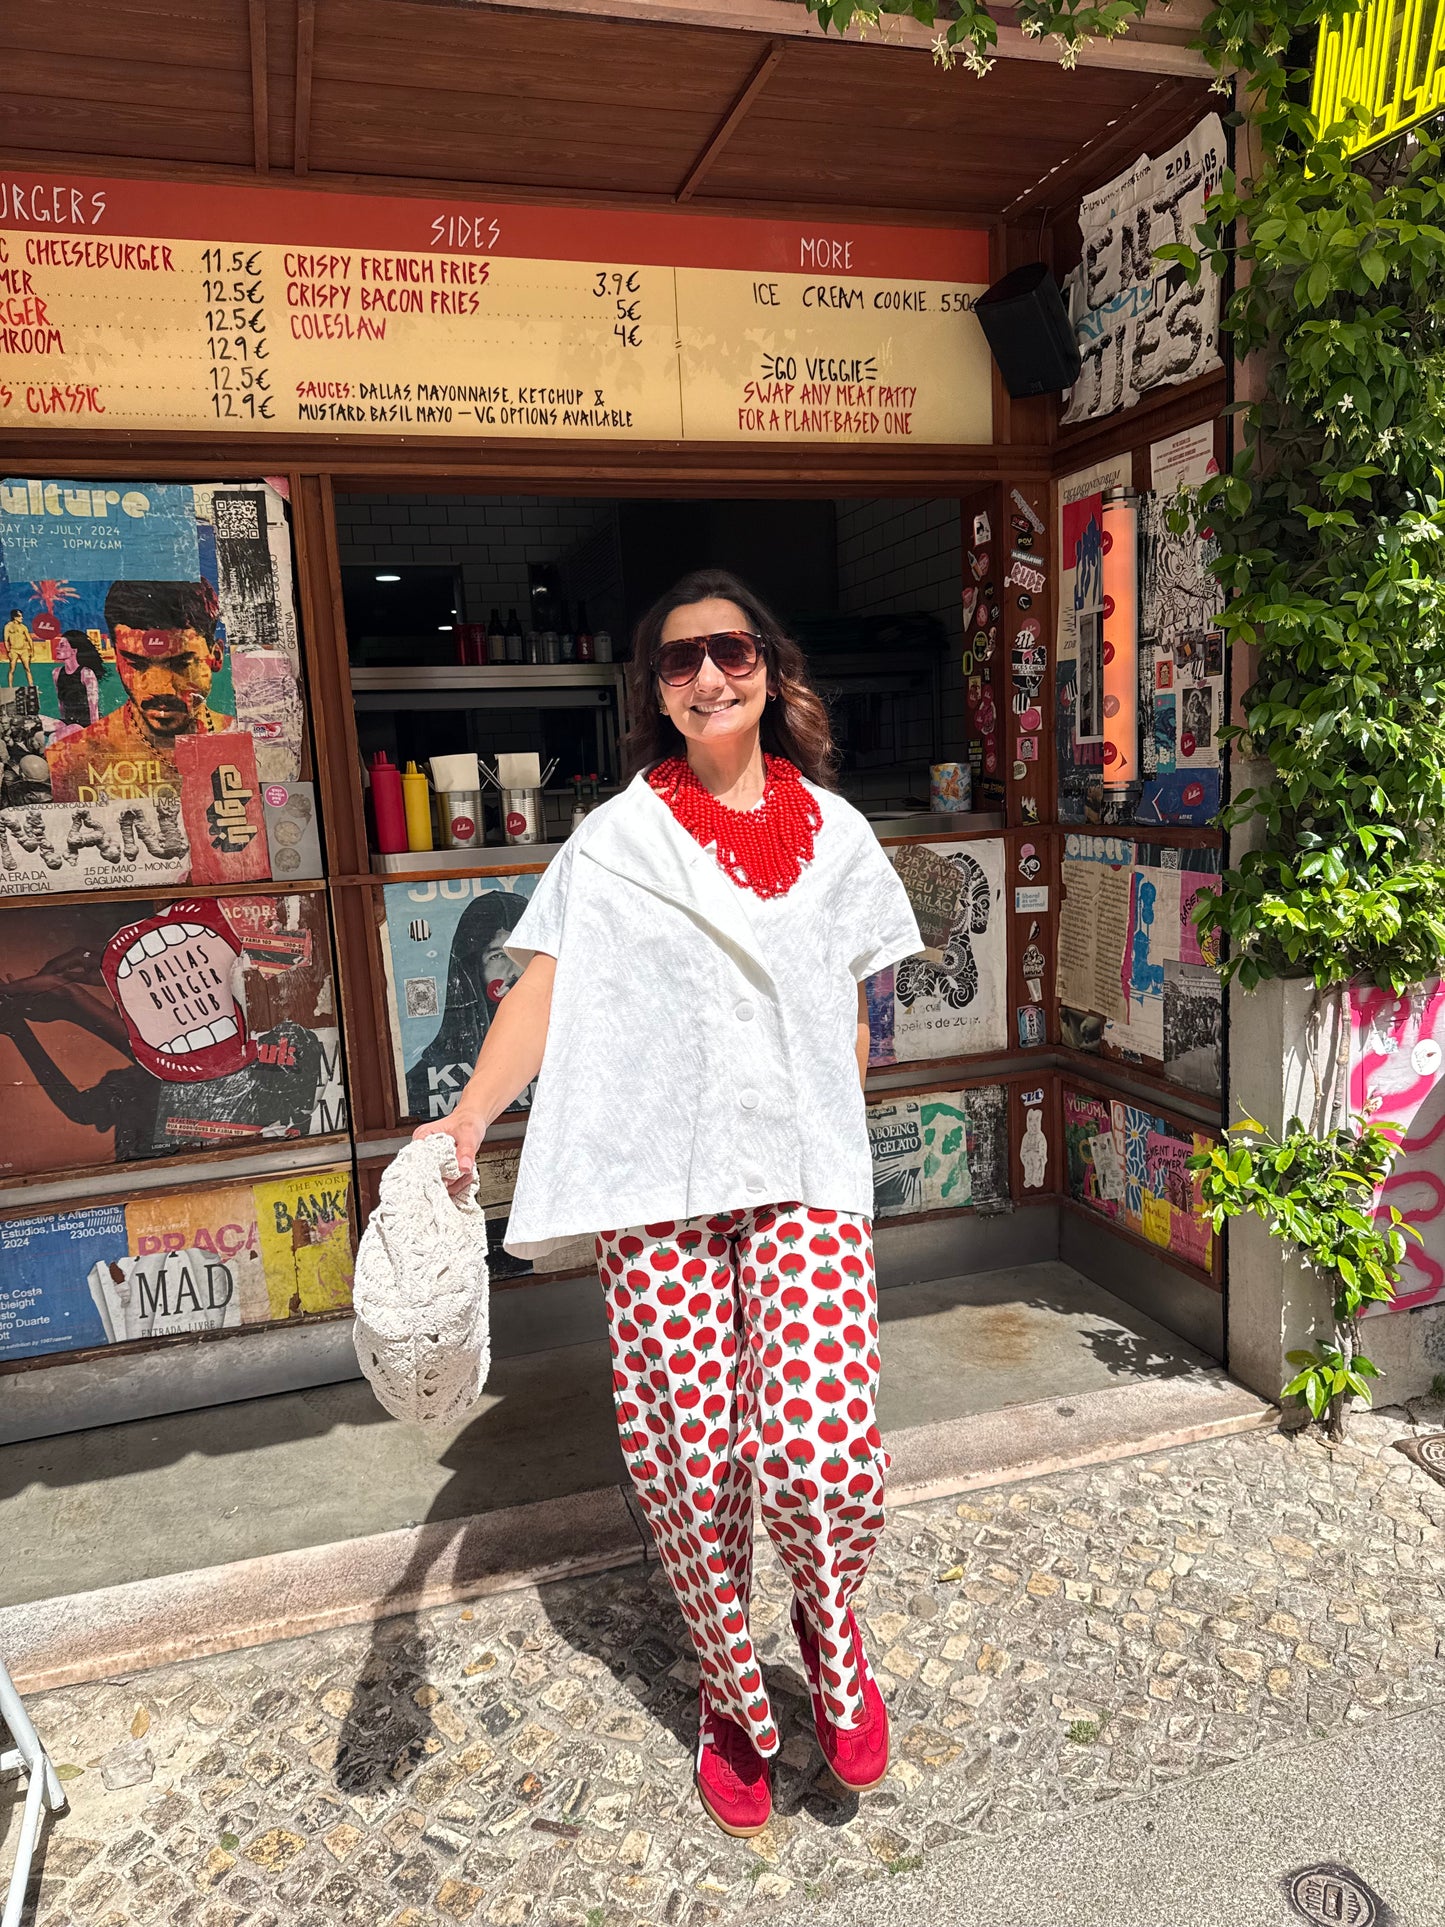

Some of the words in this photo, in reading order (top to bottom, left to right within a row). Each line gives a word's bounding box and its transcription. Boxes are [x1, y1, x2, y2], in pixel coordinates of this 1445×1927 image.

[430, 214, 502, 250] SIDES
[26, 239, 175, 272] CHEESEBURGER
[201, 248, 262, 276] 11.5€
[800, 237, 854, 271] MORE
[284, 252, 351, 280] CRISPY
[360, 257, 434, 286] FRENCH
[441, 261, 490, 287] FRIES
[593, 271, 641, 298] 3.9€
[202, 279, 265, 304] 12.5€
[286, 282, 351, 310] CRISPY
[361, 288, 424, 314] BACON
[430, 291, 480, 315] FRIES
[616, 299, 642, 321] 5€
[753, 282, 781, 306] ICE
[802, 286, 865, 310] CREAM
[873, 289, 928, 312] COOKIE
[205, 309, 266, 334] 12.5€
[290, 313, 387, 341] COLESLAW
[613, 325, 643, 347] 4€
[207, 337, 270, 361] 12.9€
[210, 367, 271, 392] 12.5€
[775, 357, 797, 381] GO
[806, 358, 864, 383] VEGGIE
[26, 385, 106, 415] CLASSIC
[211, 394, 276, 420] 12.9€
[296, 381, 355, 399] SAUCES:
[518, 387, 584, 405] KETCHUP
[744, 382, 795, 406] SWAP
[799, 384, 831, 406] ANY
[837, 385, 875, 408] MEAT
[878, 386, 917, 408] PATTY
[370, 404, 413, 422] BASIL
[416, 406, 453, 423] MAYO
[474, 406, 496, 424] VG
[500, 407, 558, 426] OPTIONS
[562, 409, 633, 428] AVAILABLE
[738, 407, 765, 430] FOR
[769, 411, 780, 431] A
[884, 411, 912, 435] ONE
[30, 525, 44, 535] 12
[53, 525, 82, 536] JULY
[91, 526, 121, 536] 2024
[62, 538, 123, 550] 10PM/6AM
[87, 760, 165, 786] MOTEL
[9, 872, 30, 882] ERA
[31, 871, 48, 881] DA
[84, 867, 96, 876] 15
[96, 866, 111, 875] DE
[111, 864, 137, 874] MAIO
[145, 861, 183, 872] MONICA
[84, 875, 134, 886] GAGLIANO
[138, 944, 210, 989] DALLAS
[149, 967, 223, 1011] BURGER
[172, 992, 220, 1027] CLUB
[935, 1018, 950, 1029] de
[875, 1121, 916, 1139] BOEING
[877, 1136, 918, 1154] GELATO
[287, 1182, 311, 1193] THE
[4, 1213, 55, 1231] Collective
[57, 1211, 66, 1223] &
[67, 1205, 123, 1222] Afterhours.
[272, 1187, 348, 1234] BANK
[1, 1224, 50, 1242] Estudios,
[51, 1219, 85, 1233] Lisboa
[69, 1223, 124, 1240] 2300-0400
[11, 1286, 43, 1299] Costa
[135, 1263, 235, 1319] MAD
[15, 1315, 51, 1329] Duarte
[187, 1319, 216, 1332] LIVRE
